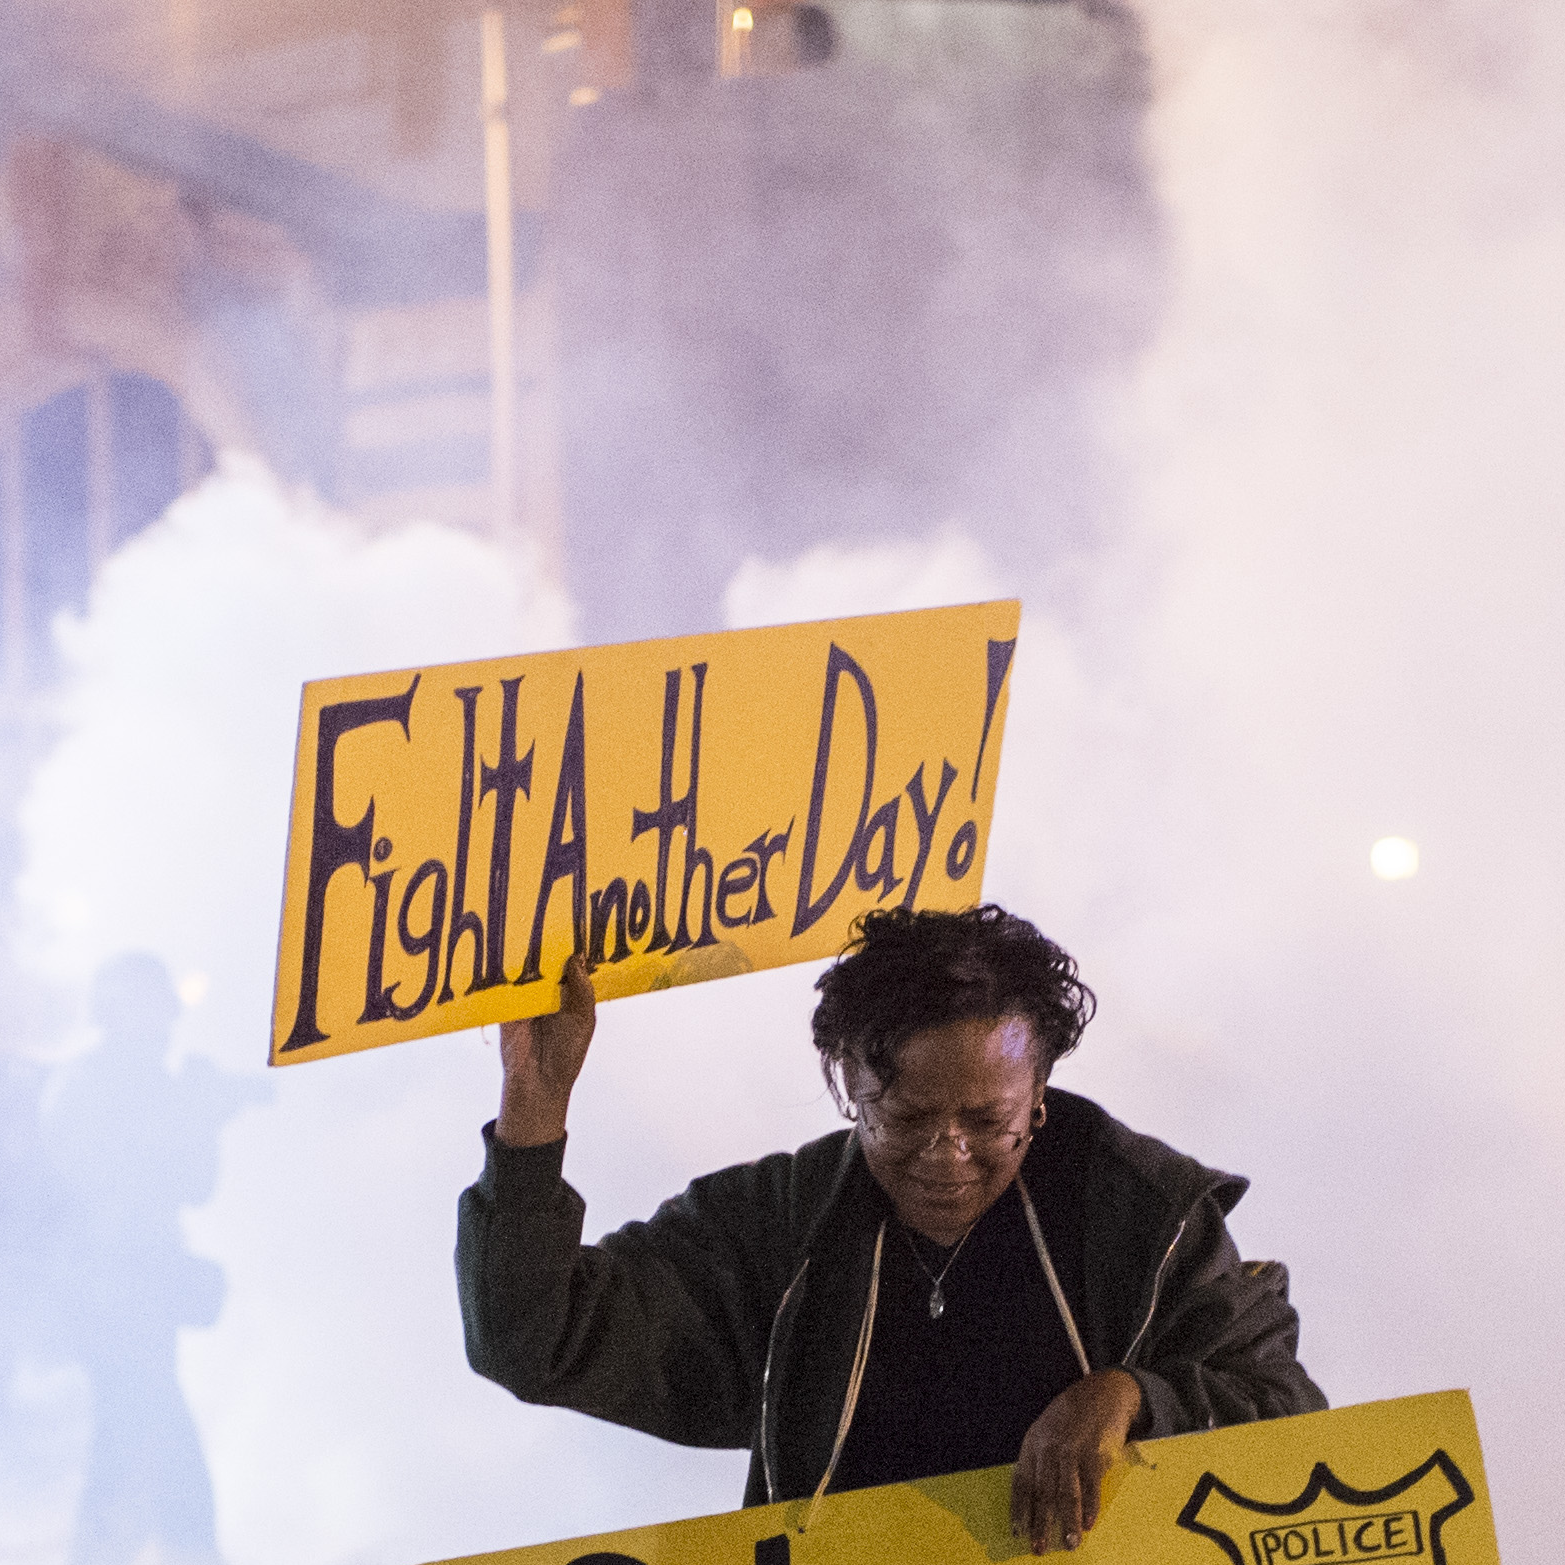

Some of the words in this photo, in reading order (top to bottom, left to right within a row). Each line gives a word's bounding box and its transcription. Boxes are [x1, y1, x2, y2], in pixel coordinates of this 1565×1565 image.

[280, 674, 535, 1052] Fight
[514, 662, 796, 984] Another
[791, 638, 1017, 939] Day!
